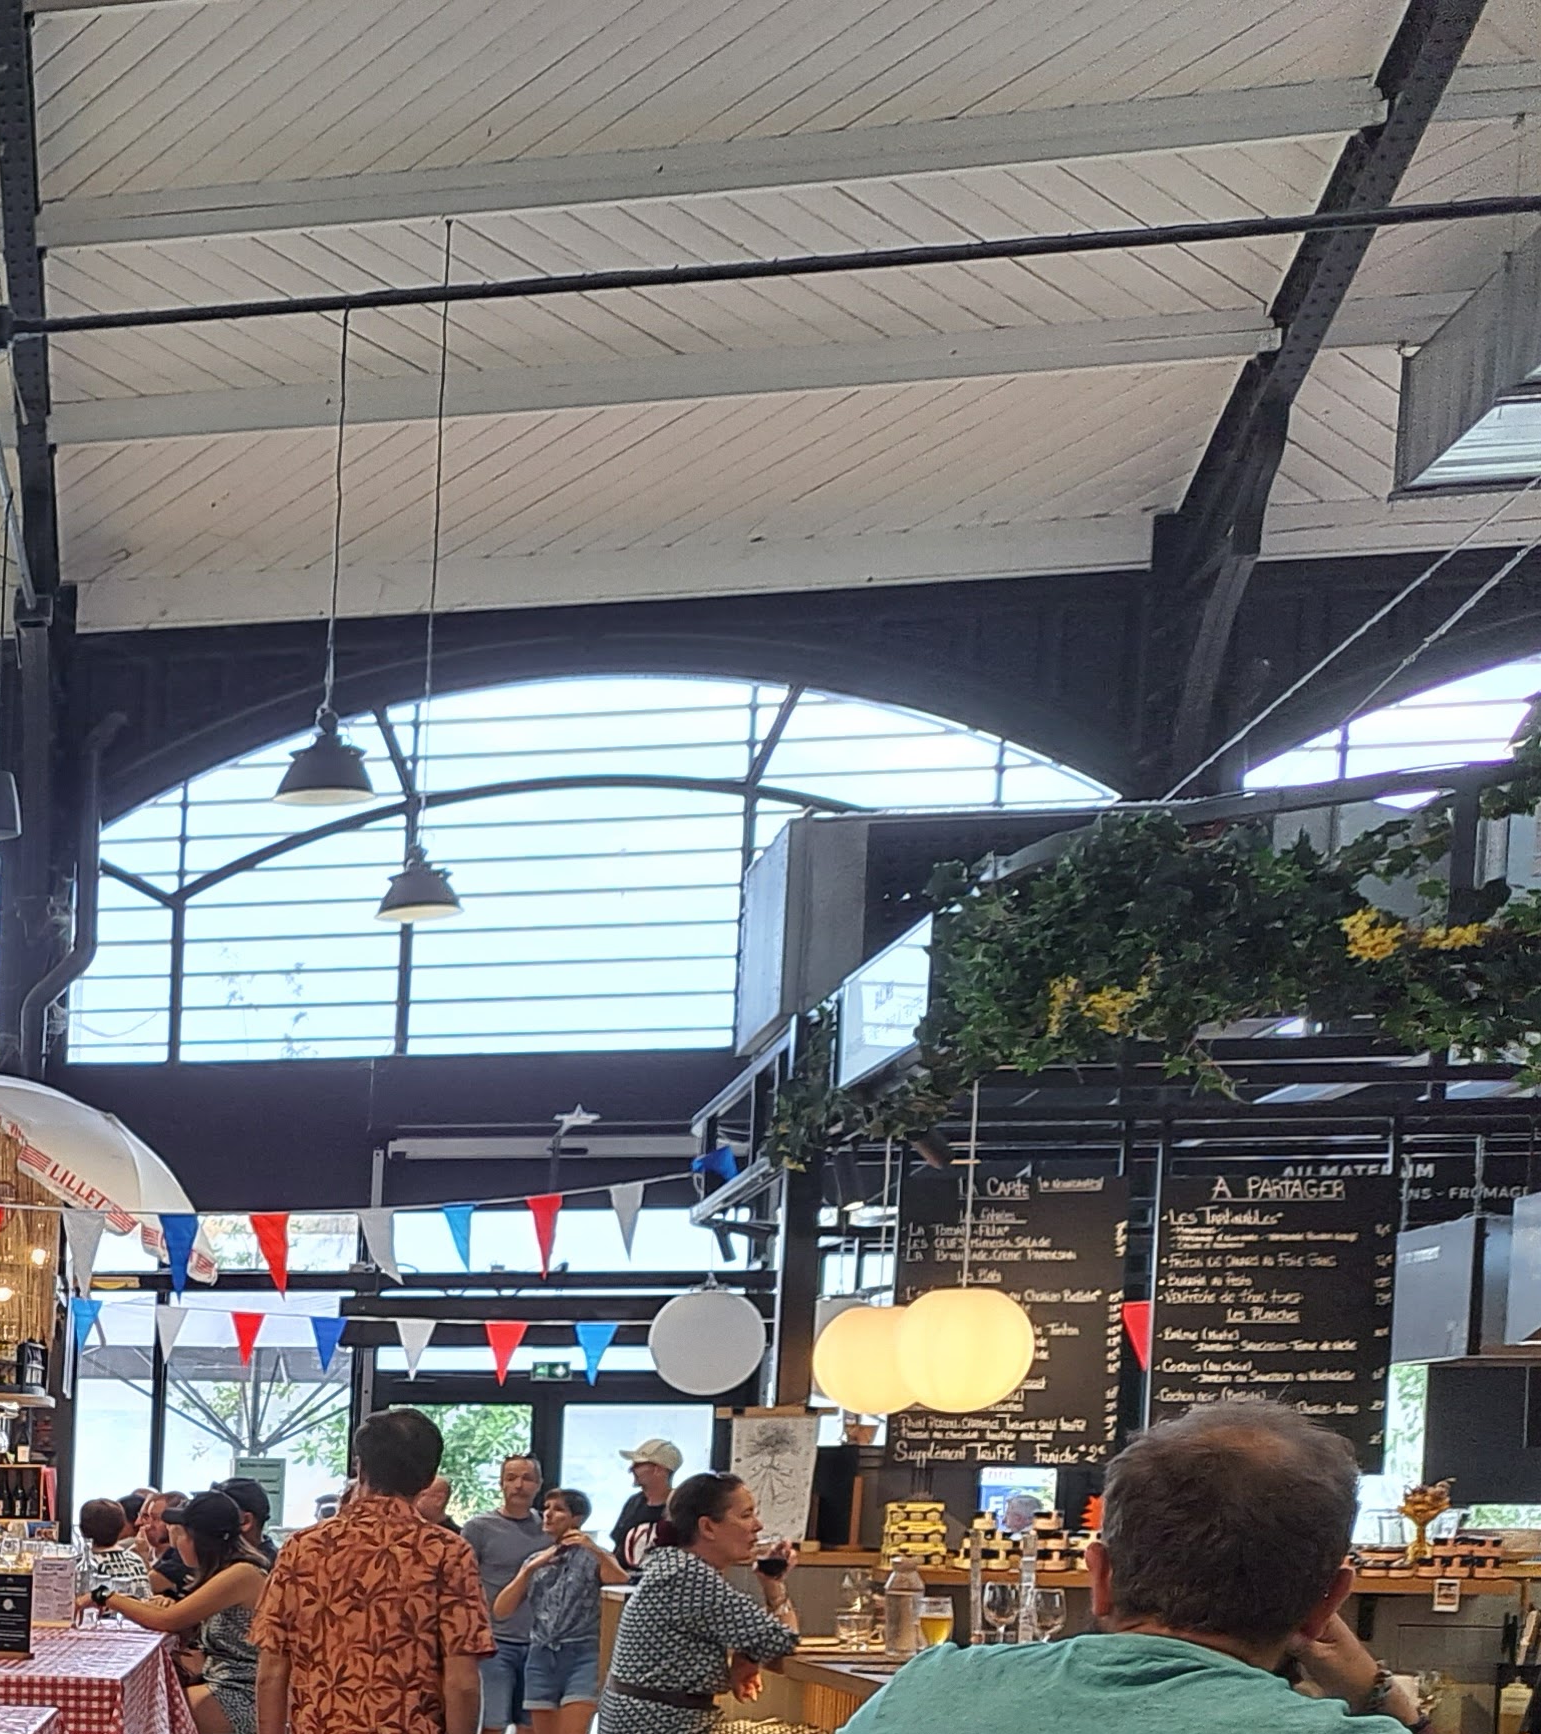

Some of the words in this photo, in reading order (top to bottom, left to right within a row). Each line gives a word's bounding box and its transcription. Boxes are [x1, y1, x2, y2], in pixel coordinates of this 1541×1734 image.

[49, 1164, 109, 1210] LILLET
[1247, 1178, 1345, 1199] PARTAGER
[894, 1440, 966, 1468] Supplément
